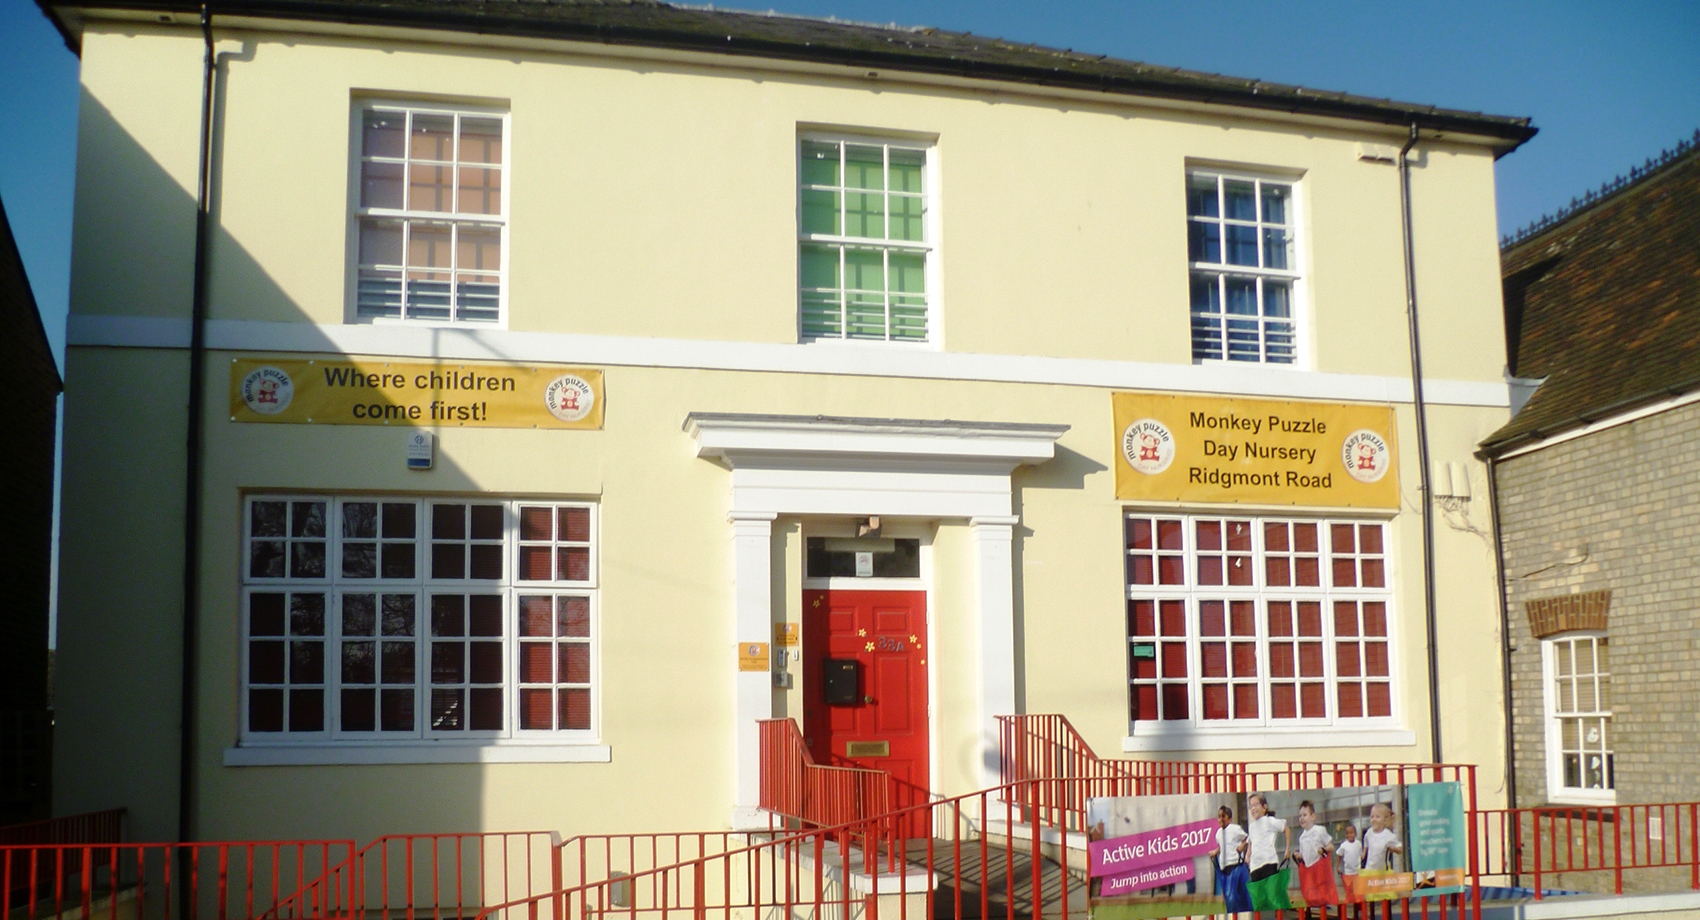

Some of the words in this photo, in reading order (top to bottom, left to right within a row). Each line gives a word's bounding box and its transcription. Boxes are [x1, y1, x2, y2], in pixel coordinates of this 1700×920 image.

[245, 371, 262, 403] monkey
[263, 369, 289, 387] puzzle
[325, 366, 406, 389] Where
[414, 370, 517, 392] children
[548, 379, 564, 410] monkey
[565, 377, 590, 395] puzzle
[352, 402, 423, 420] come
[430, 400, 488, 422] first!
[1190, 412, 1262, 435] Monkey
[1268, 415, 1327, 435] Puzzle
[1126, 424, 1142, 460] monkey
[1143, 422, 1170, 442] puzzle
[1203, 440, 1239, 460] Day
[1245, 442, 1317, 464] Nursery
[1345, 435, 1360, 469] monkey
[1361, 433, 1385, 452] puzzle
[1189, 467, 1281, 489] Ridgmont
[1286, 471, 1333, 489] Road
[1102, 837, 1145, 865] Active
[1147, 832, 1179, 854] Kids
[1181, 827, 1212, 849] 2017
[1110, 874, 1139, 890] Jump
[1140, 869, 1158, 884] into
[1159, 864, 1188, 880] action
